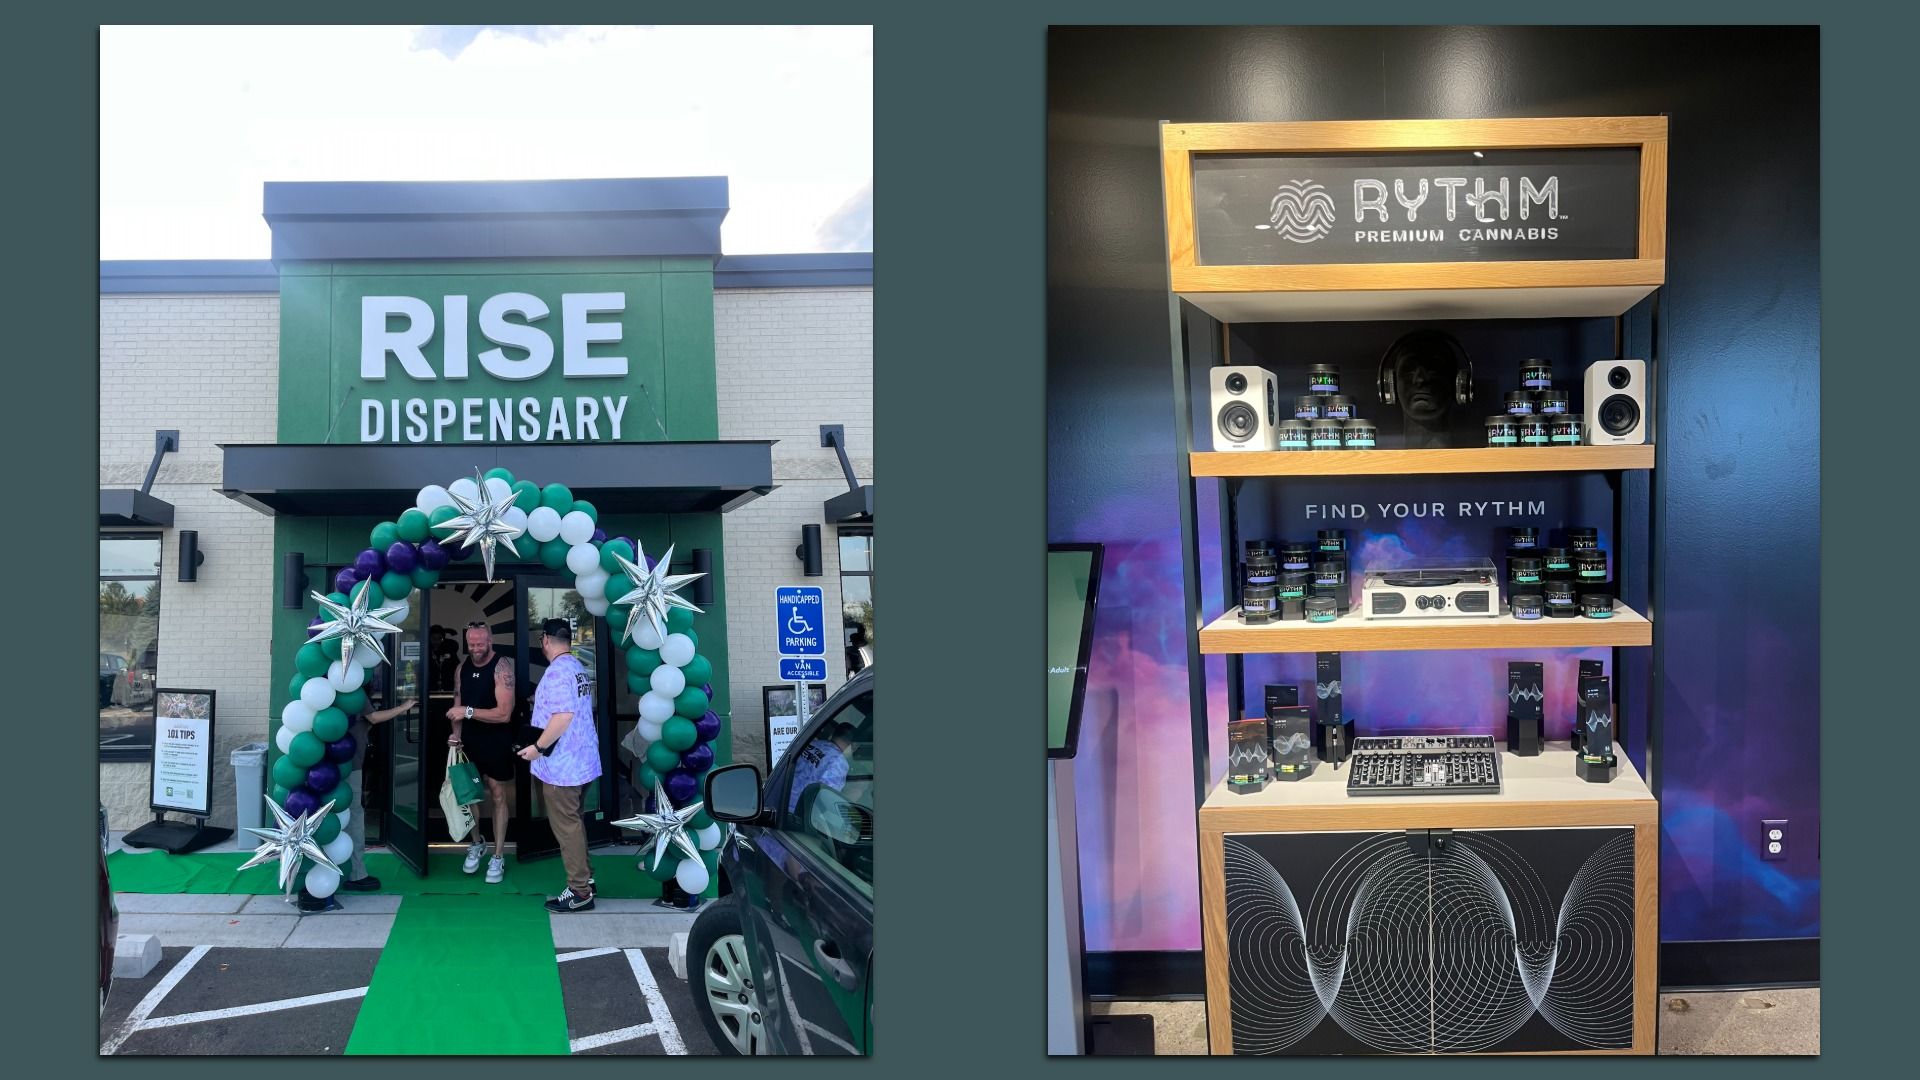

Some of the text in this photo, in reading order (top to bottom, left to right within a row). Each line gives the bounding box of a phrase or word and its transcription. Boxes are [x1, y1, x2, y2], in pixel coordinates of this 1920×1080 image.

[1354, 176, 1558, 222] RYTHM
[1355, 228, 1559, 243] PREMIUM CANNABIS
[361, 292, 629, 381] RISE
[361, 396, 628, 443] DISPENSARY
[1306, 501, 1545, 519] FIND YOUR RYTHM
[780, 595, 819, 604] HANDICAPPED
[786, 638, 817, 647] PARKING
[795, 662, 811, 670] VAN
[168, 729, 195, 740] 101 TIPS
[773, 726, 798, 735] ARE OUR
